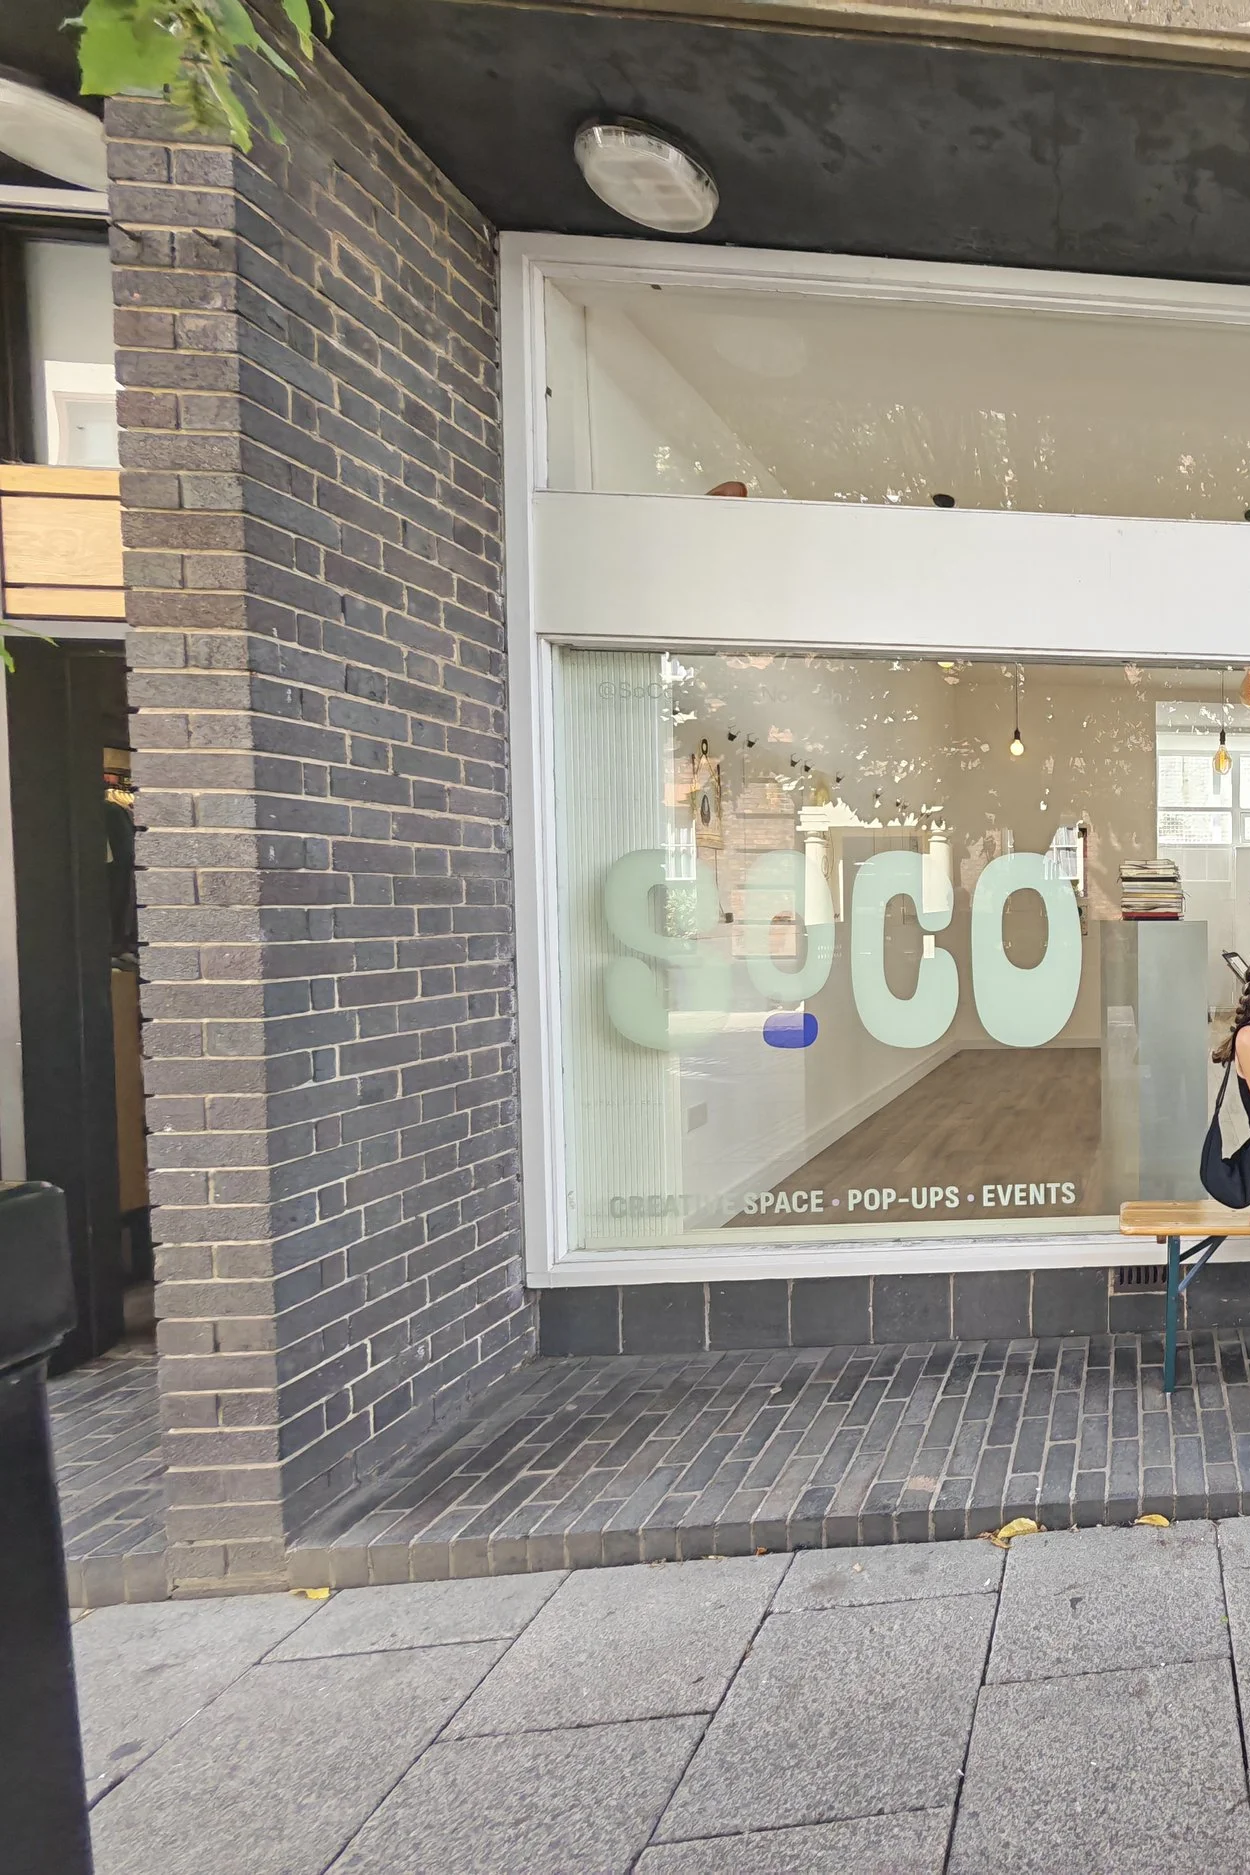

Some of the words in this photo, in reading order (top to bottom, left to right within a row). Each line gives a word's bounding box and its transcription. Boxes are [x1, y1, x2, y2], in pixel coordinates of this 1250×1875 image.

[610, 1193, 736, 1219] CREATIVE
[743, 1190, 825, 1216] SPACE
[847, 1184, 960, 1212] POP-UPS
[982, 1181, 1077, 1208] EVENTS
